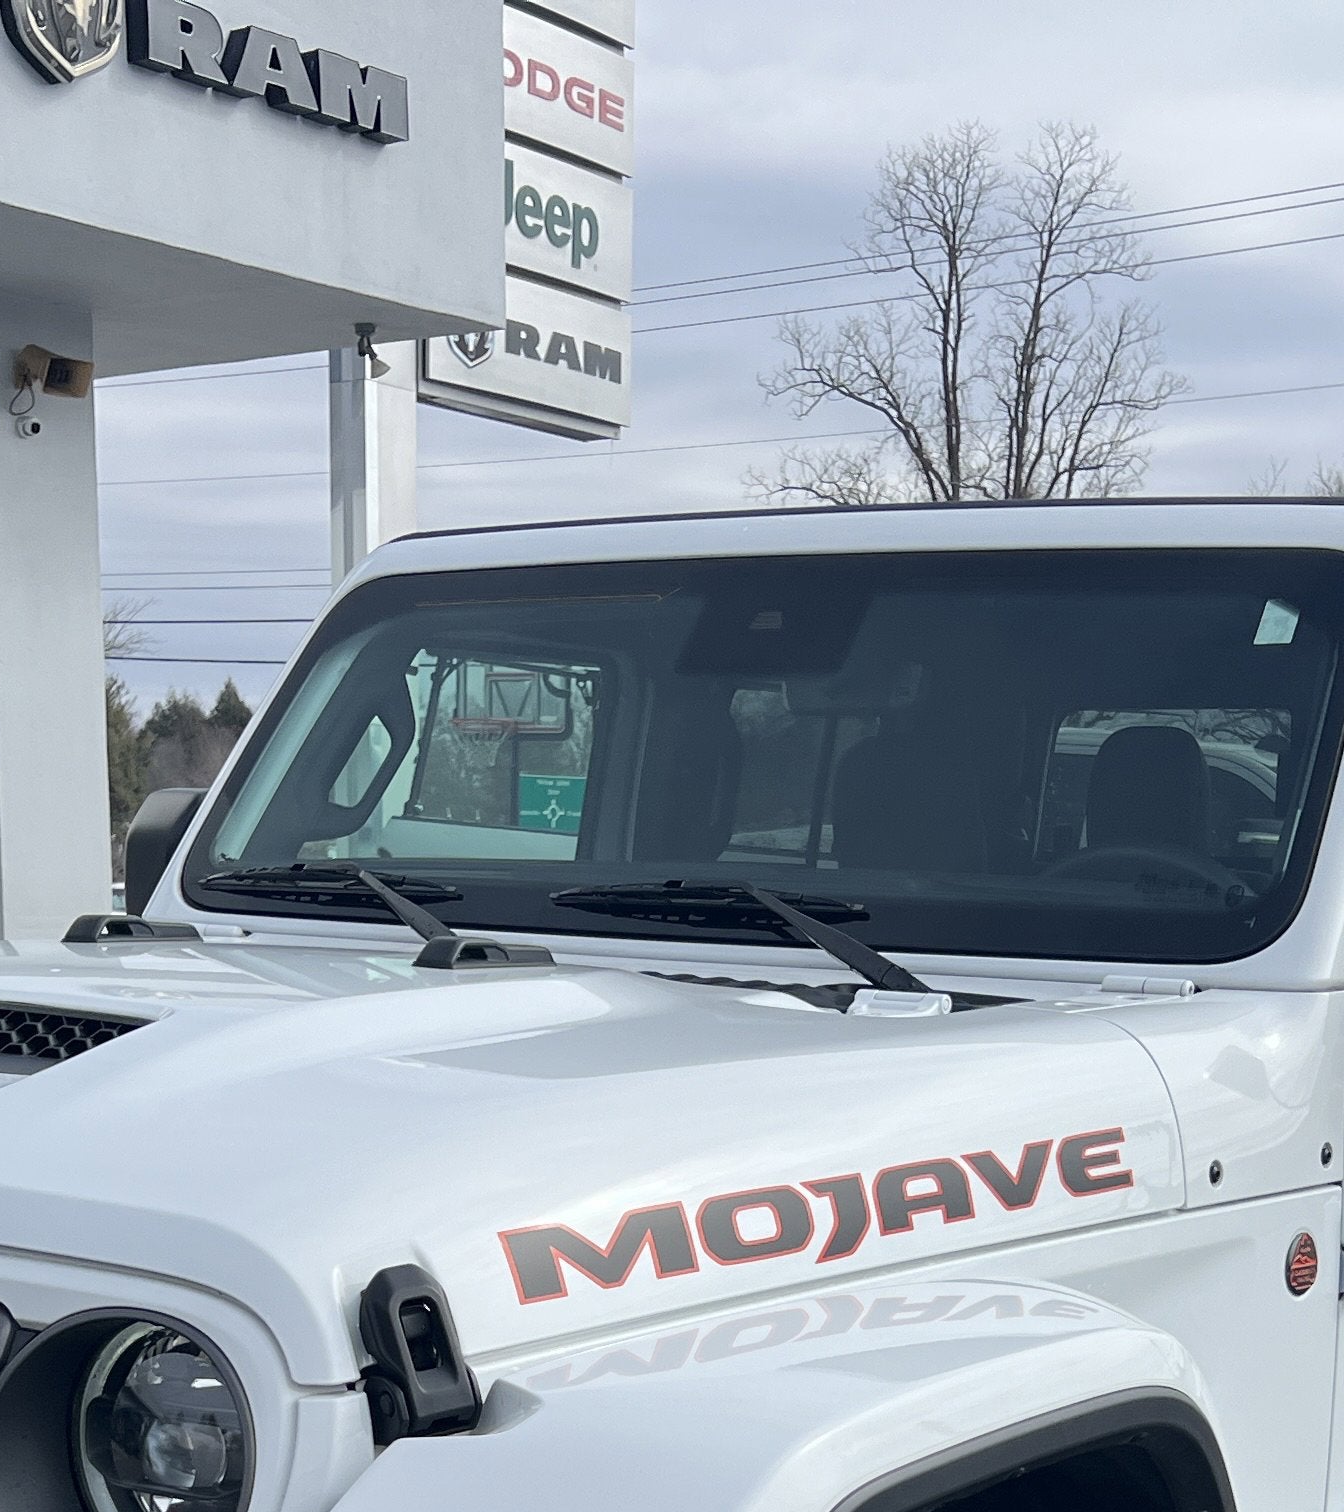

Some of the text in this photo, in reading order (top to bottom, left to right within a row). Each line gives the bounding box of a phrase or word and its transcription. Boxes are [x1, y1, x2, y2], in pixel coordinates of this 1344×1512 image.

[128, 0, 409, 143] RAM
[503, 48, 624, 132] ODGE
[505, 318, 622, 384] RAM
[497, 1126, 1134, 1305] MOJAVE
